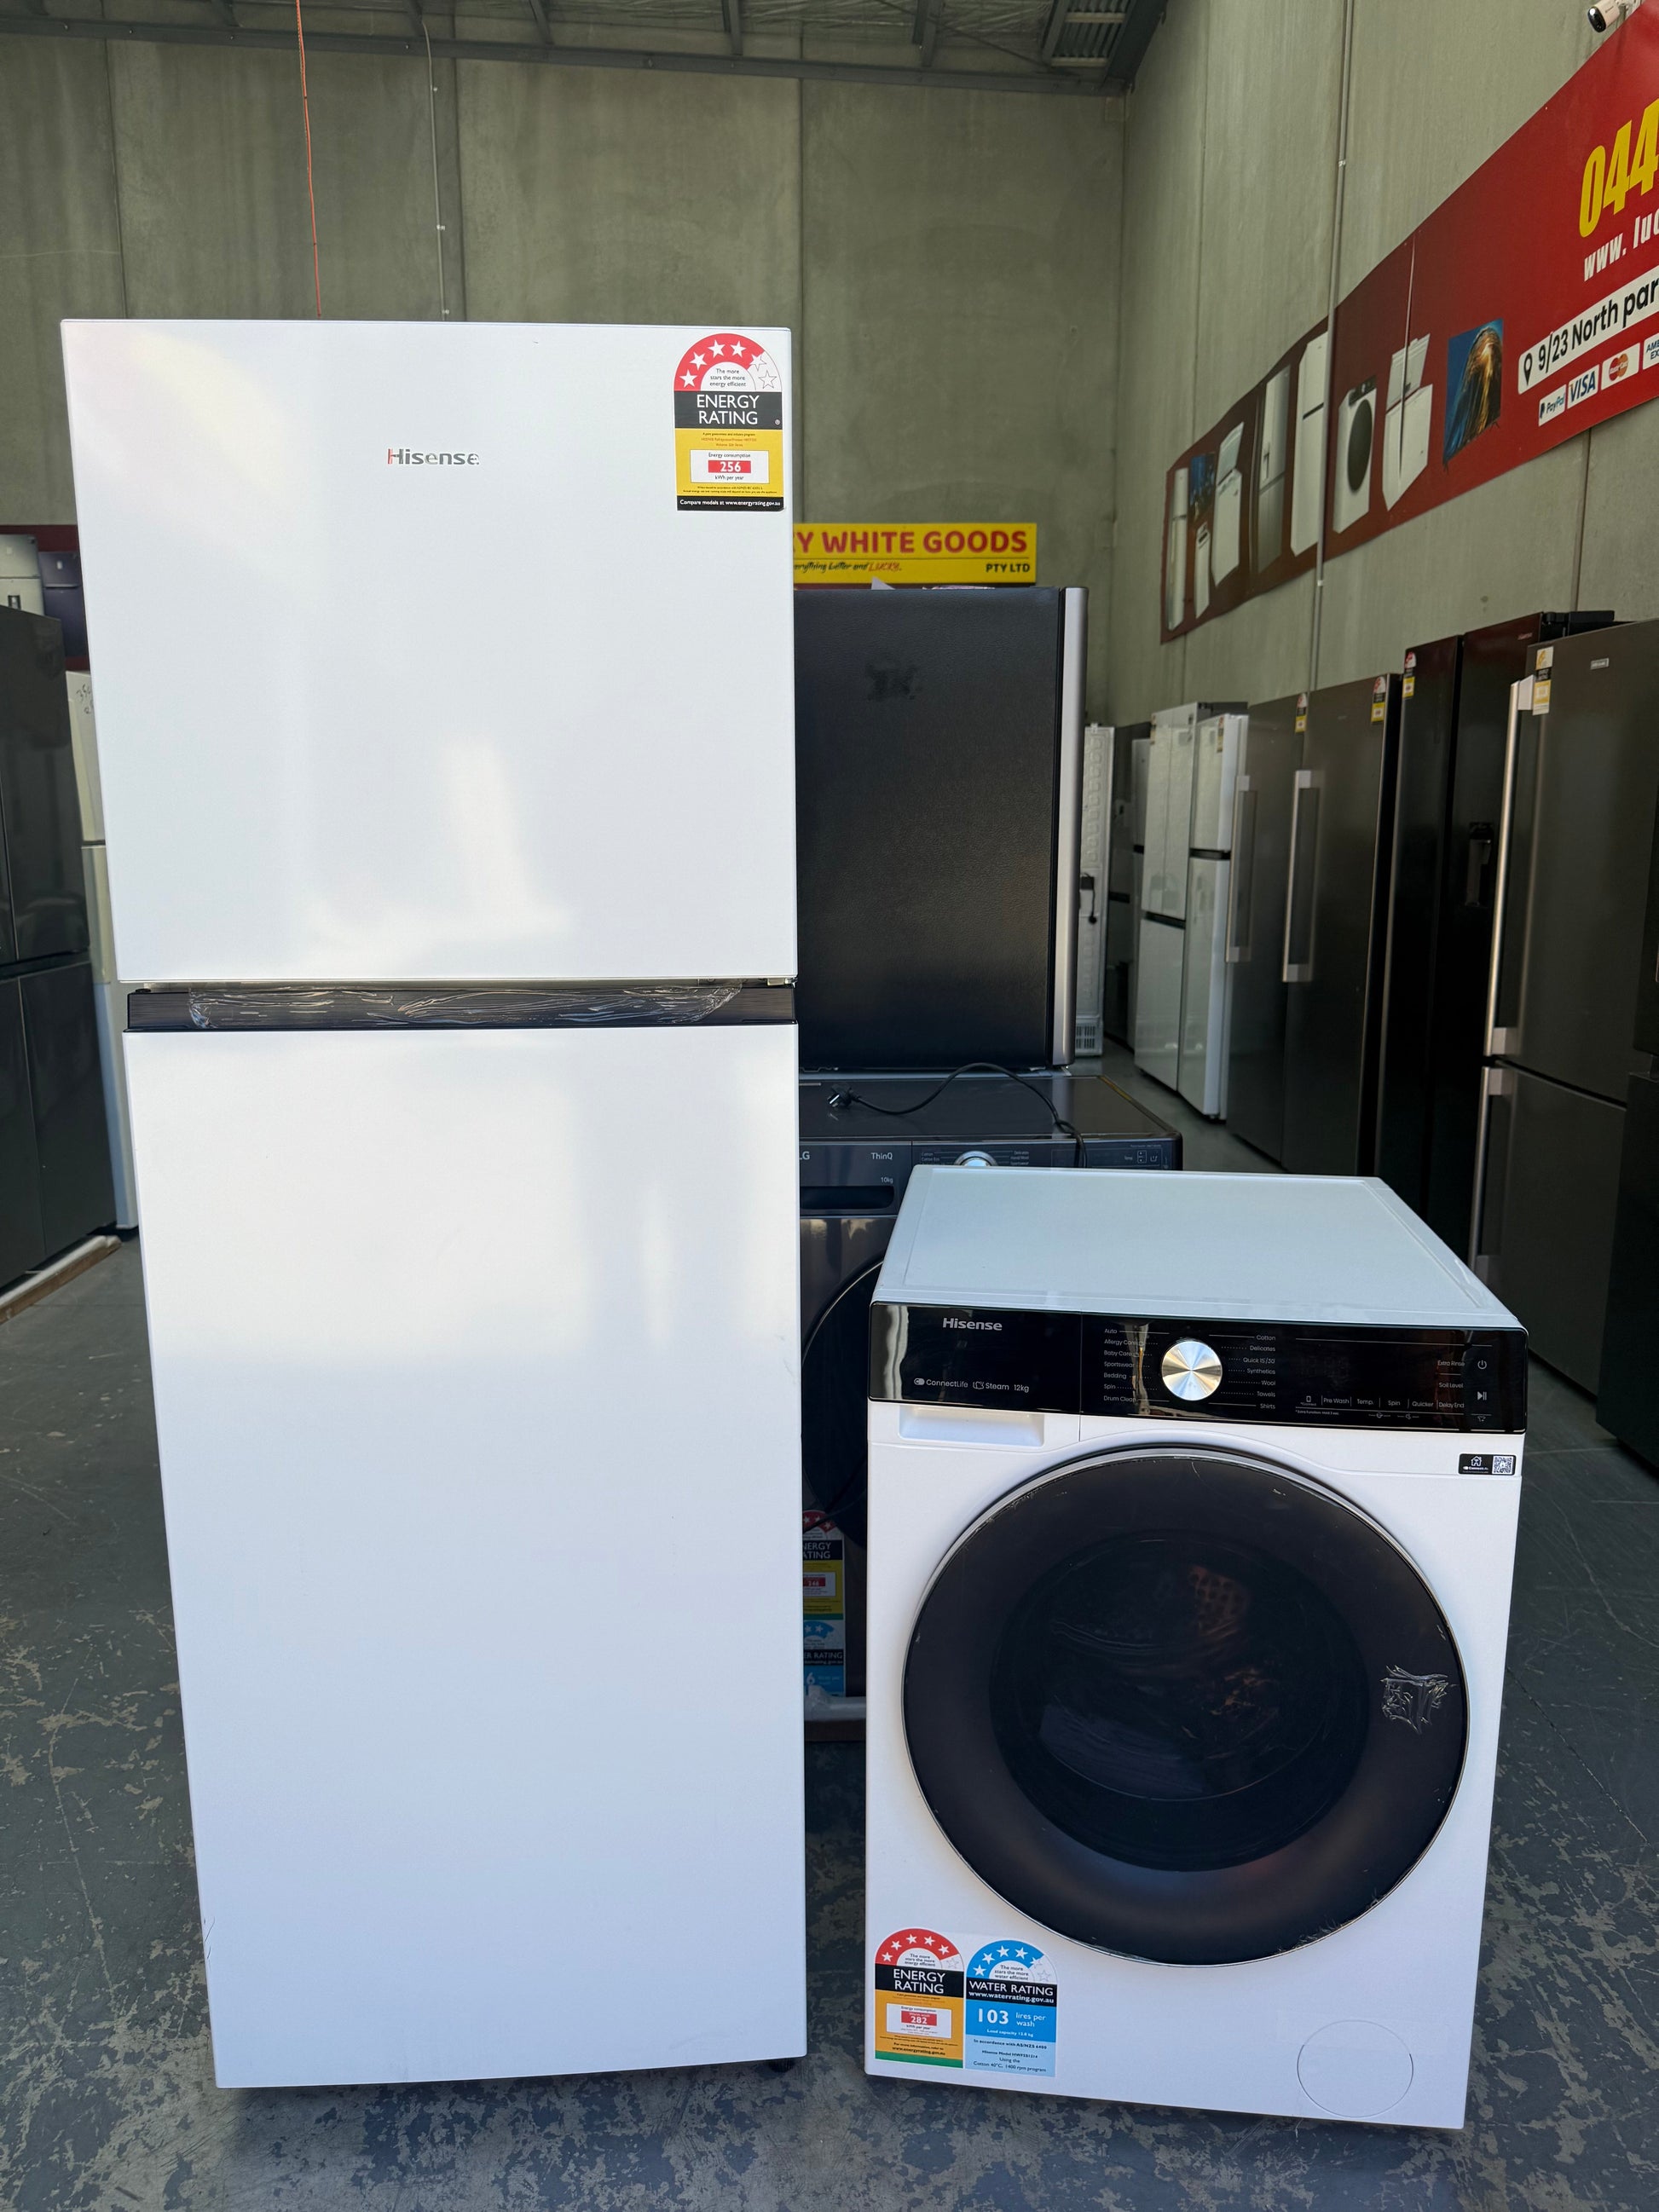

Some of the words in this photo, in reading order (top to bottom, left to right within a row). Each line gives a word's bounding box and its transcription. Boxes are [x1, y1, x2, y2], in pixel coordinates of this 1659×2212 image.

[1584, 232, 1627, 282] www.
[1538, 329, 1569, 374] 9/23
[1572, 298, 1618, 351] North
[1569, 371, 1596, 402] VISA
[697, 394, 760, 409] ENERGY
[1546, 392, 1565, 414] PayPal
[699, 410, 758, 424] RATING
[387, 448, 480, 465] Hisense
[720, 461, 742, 472] 256
[822, 531, 915, 554] WHITE
[923, 530, 1027, 553] GOODS
[986, 563, 1009, 573] PTY
[1009, 563, 1030, 573] LTD
[942, 1317, 1003, 1331] Hisense
[926, 1378, 968, 1389] ConnectLife
[986, 1383, 1009, 1391] Steam
[1014, 1383, 1029, 1394] 12kg
[893, 1968, 945, 1983] ENERGY
[894, 1979, 944, 1994] RATING
[968, 1980, 1007, 1992] WATER
[1011, 1984, 1054, 1996] RATING
[968, 1990, 1055, 2003] www.waterrating.gov.au
[910, 2016, 928, 2024] 282
[978, 2008, 1009, 2024] 103
